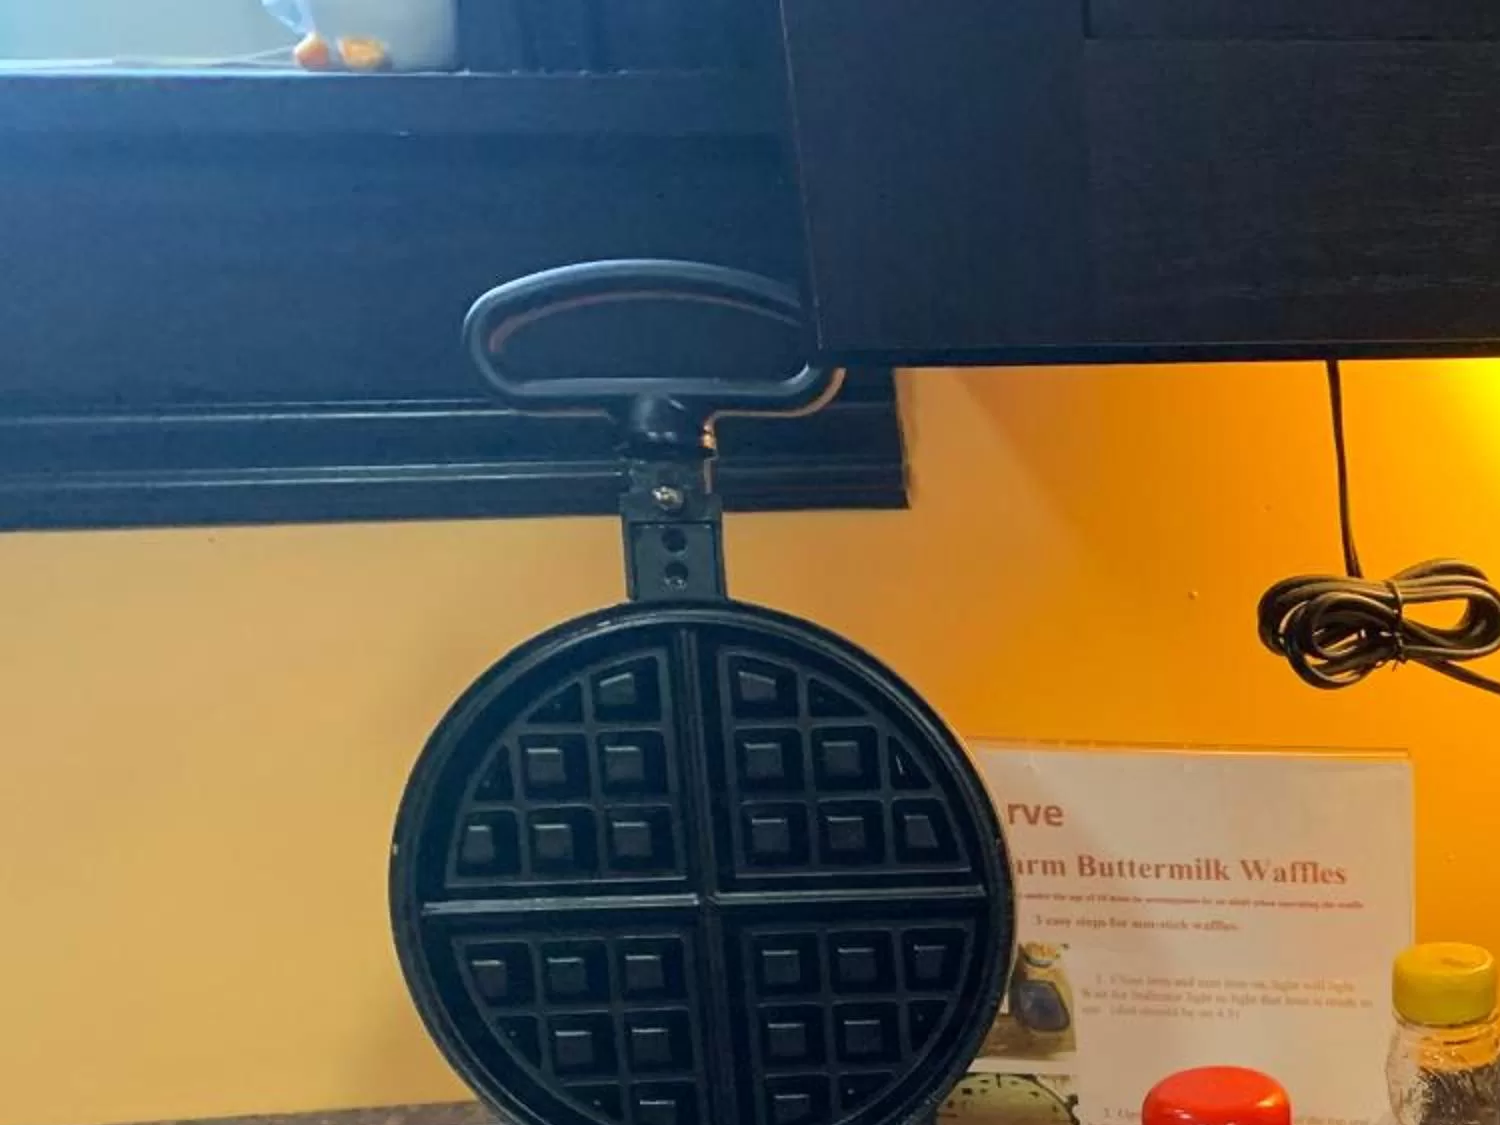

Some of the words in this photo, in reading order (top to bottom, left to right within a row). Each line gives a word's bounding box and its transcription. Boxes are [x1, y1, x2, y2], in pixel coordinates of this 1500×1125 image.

[1007, 803, 1064, 827] rve
[1015, 858, 1066, 877] arm
[1077, 855, 1231, 881] Buttermilk
[1239, 858, 1348, 885] Waffles
